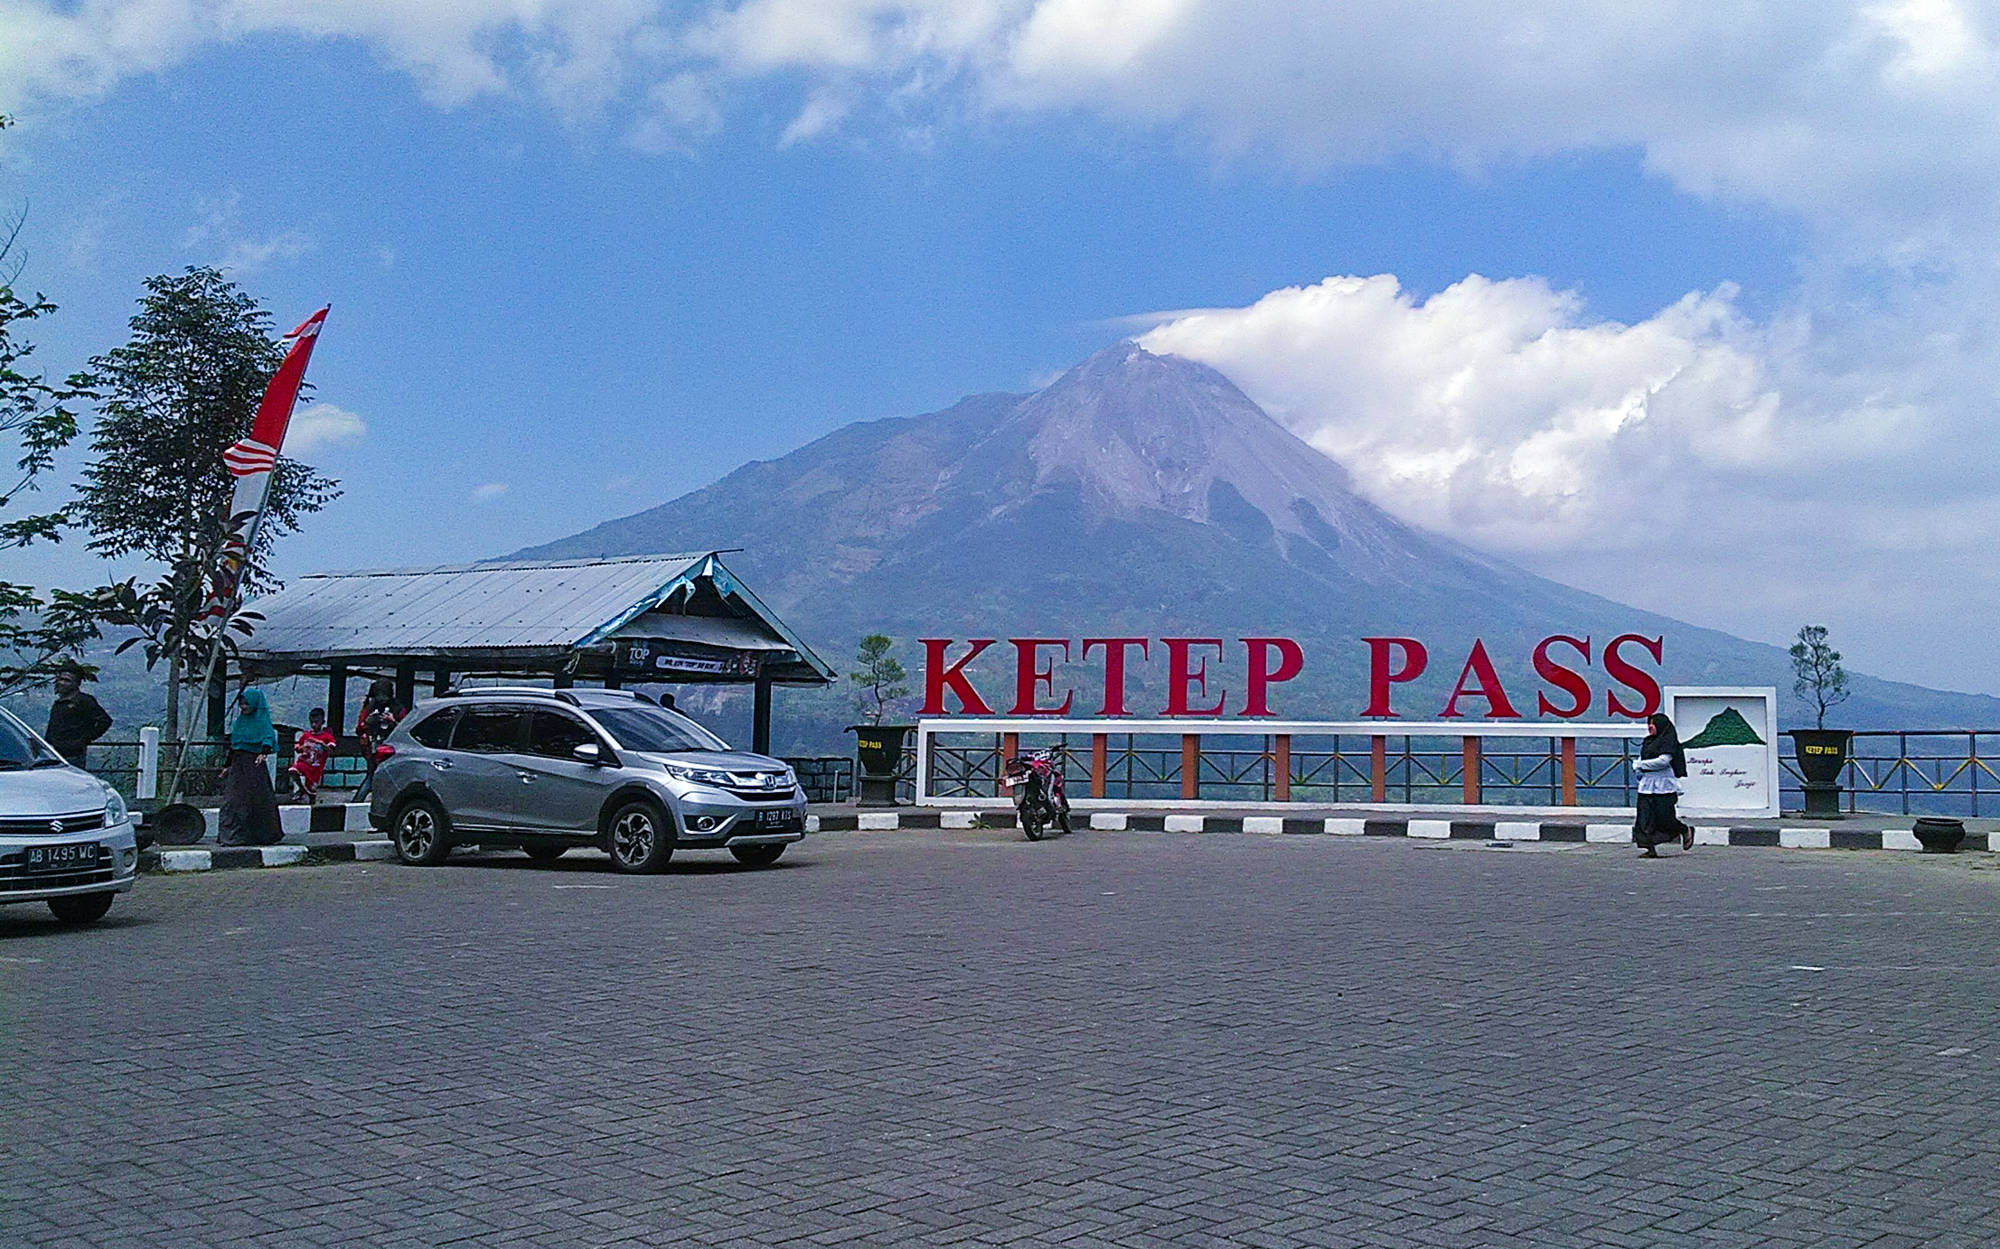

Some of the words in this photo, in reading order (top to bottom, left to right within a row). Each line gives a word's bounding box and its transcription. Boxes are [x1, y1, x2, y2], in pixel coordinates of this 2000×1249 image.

[630, 647, 650, 660] TOP
[916, 638, 1304, 717] KETEP
[1359, 633, 1664, 718] PASS
[30, 849, 43, 863] AB
[48, 846, 75, 862] 1495
[80, 844, 94, 859] WC
